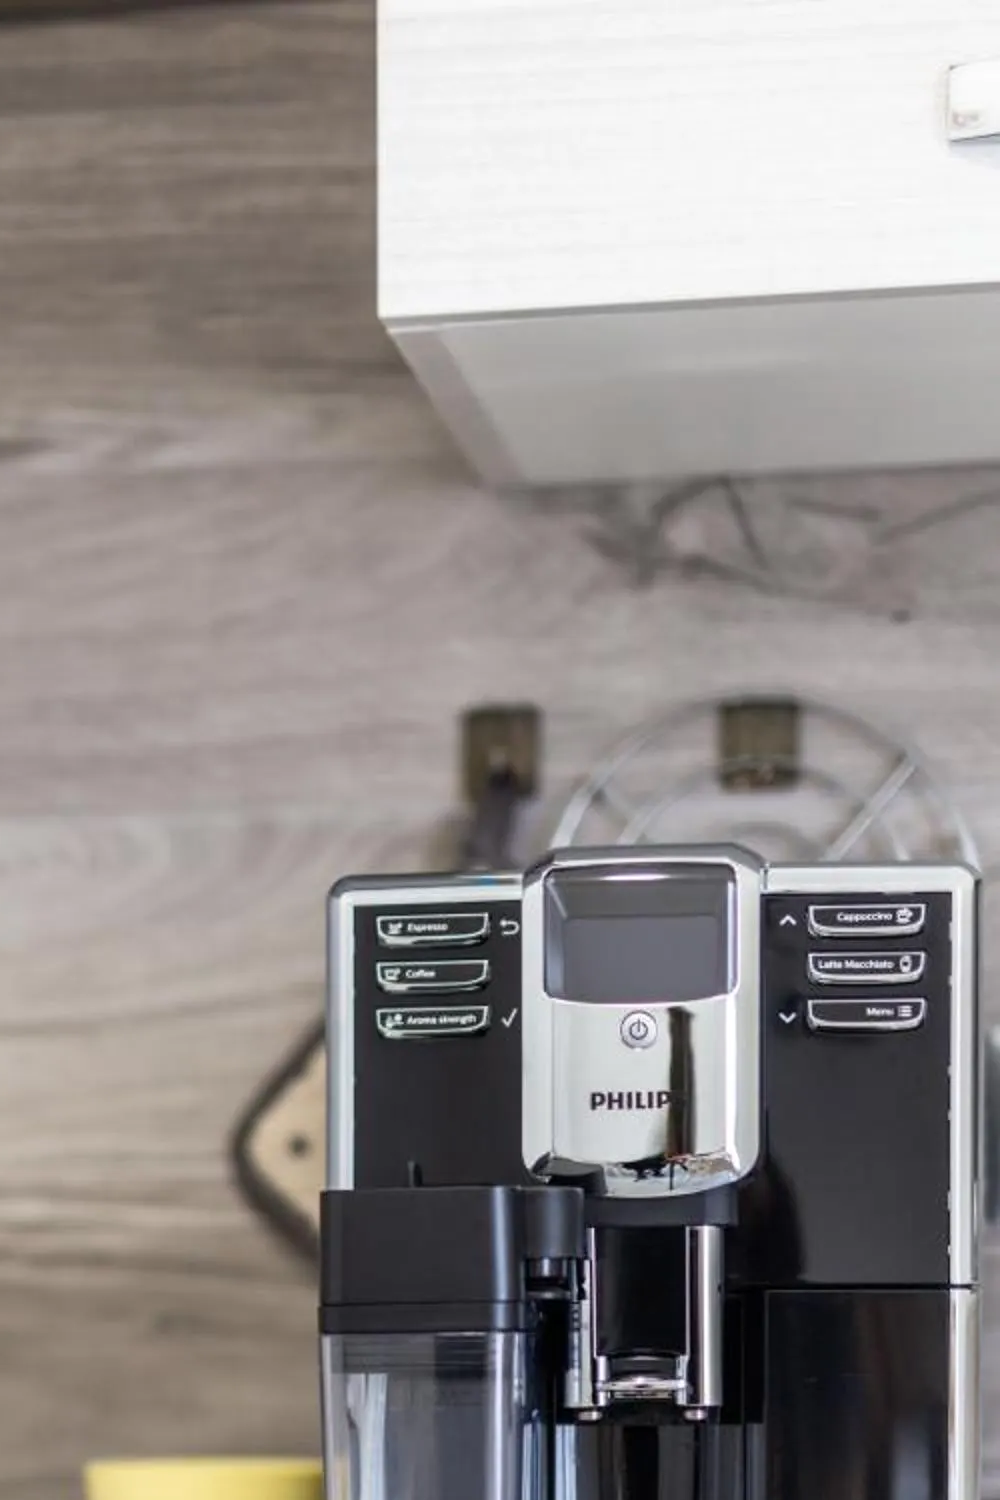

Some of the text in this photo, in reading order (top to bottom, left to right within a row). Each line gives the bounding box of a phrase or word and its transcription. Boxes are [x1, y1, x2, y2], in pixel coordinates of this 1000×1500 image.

[837, 911, 893, 922] Cappuccino
[407, 922, 449, 932] Espresso
[818, 959, 895, 970] Latte Macchiato
[405, 969, 436, 979] Coffee
[866, 1007, 894, 1016] Menu
[407, 1013, 477, 1026] Aroma strength
[590, 1091, 684, 1110] PHILIP
